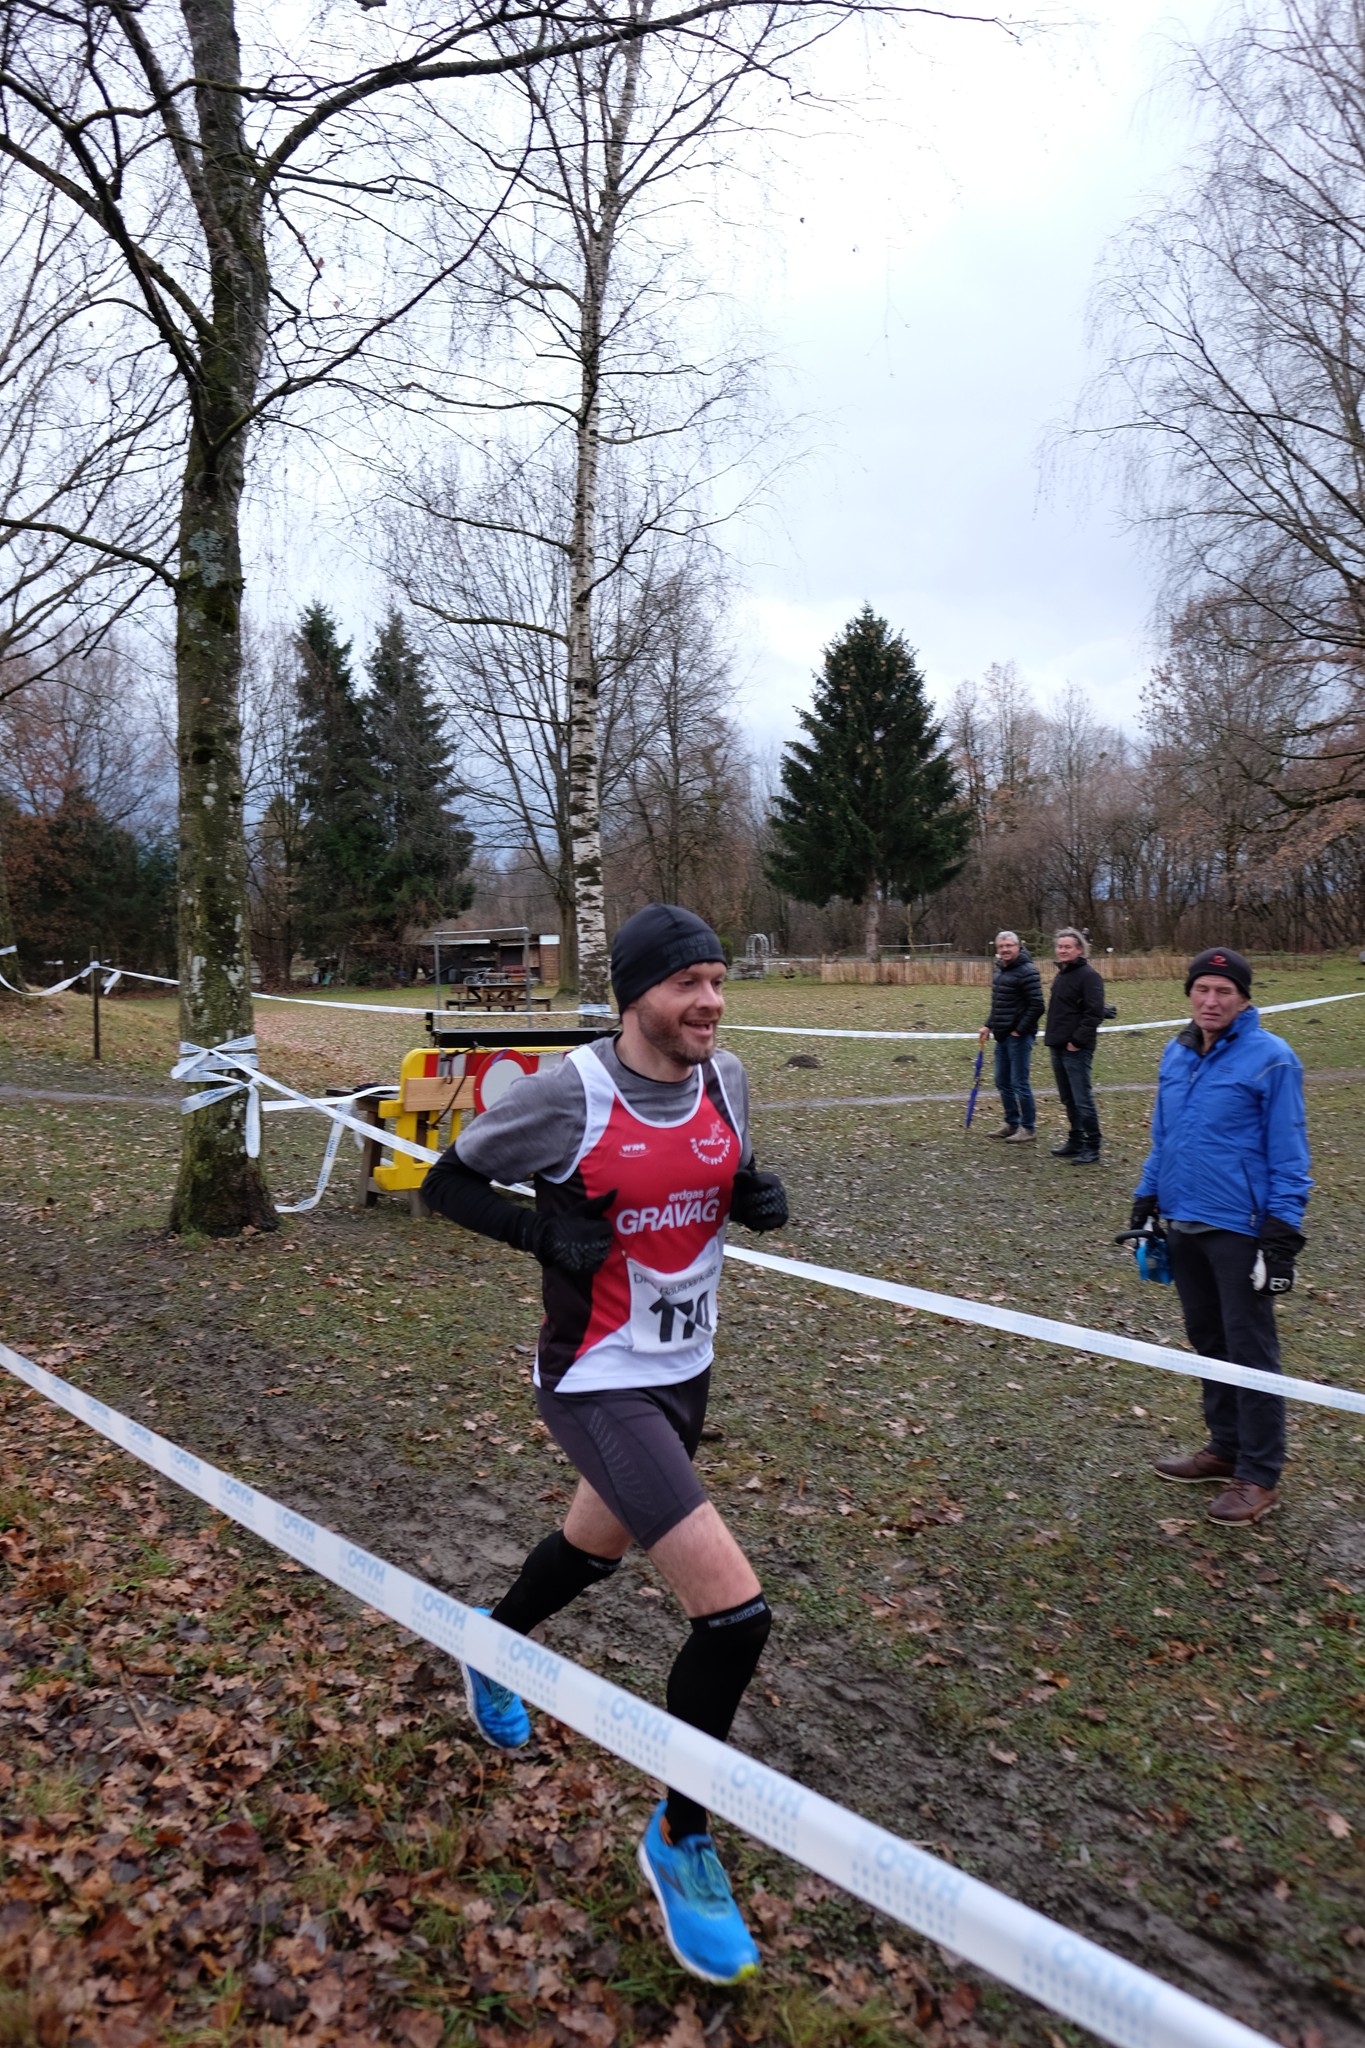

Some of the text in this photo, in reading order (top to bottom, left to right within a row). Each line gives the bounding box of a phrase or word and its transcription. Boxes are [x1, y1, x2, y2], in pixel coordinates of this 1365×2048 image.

[690, 1135, 731, 1166] RHEINTAL
[668, 1188, 705, 1203] erdgas
[616, 1199, 720, 1236] GRAVAG
